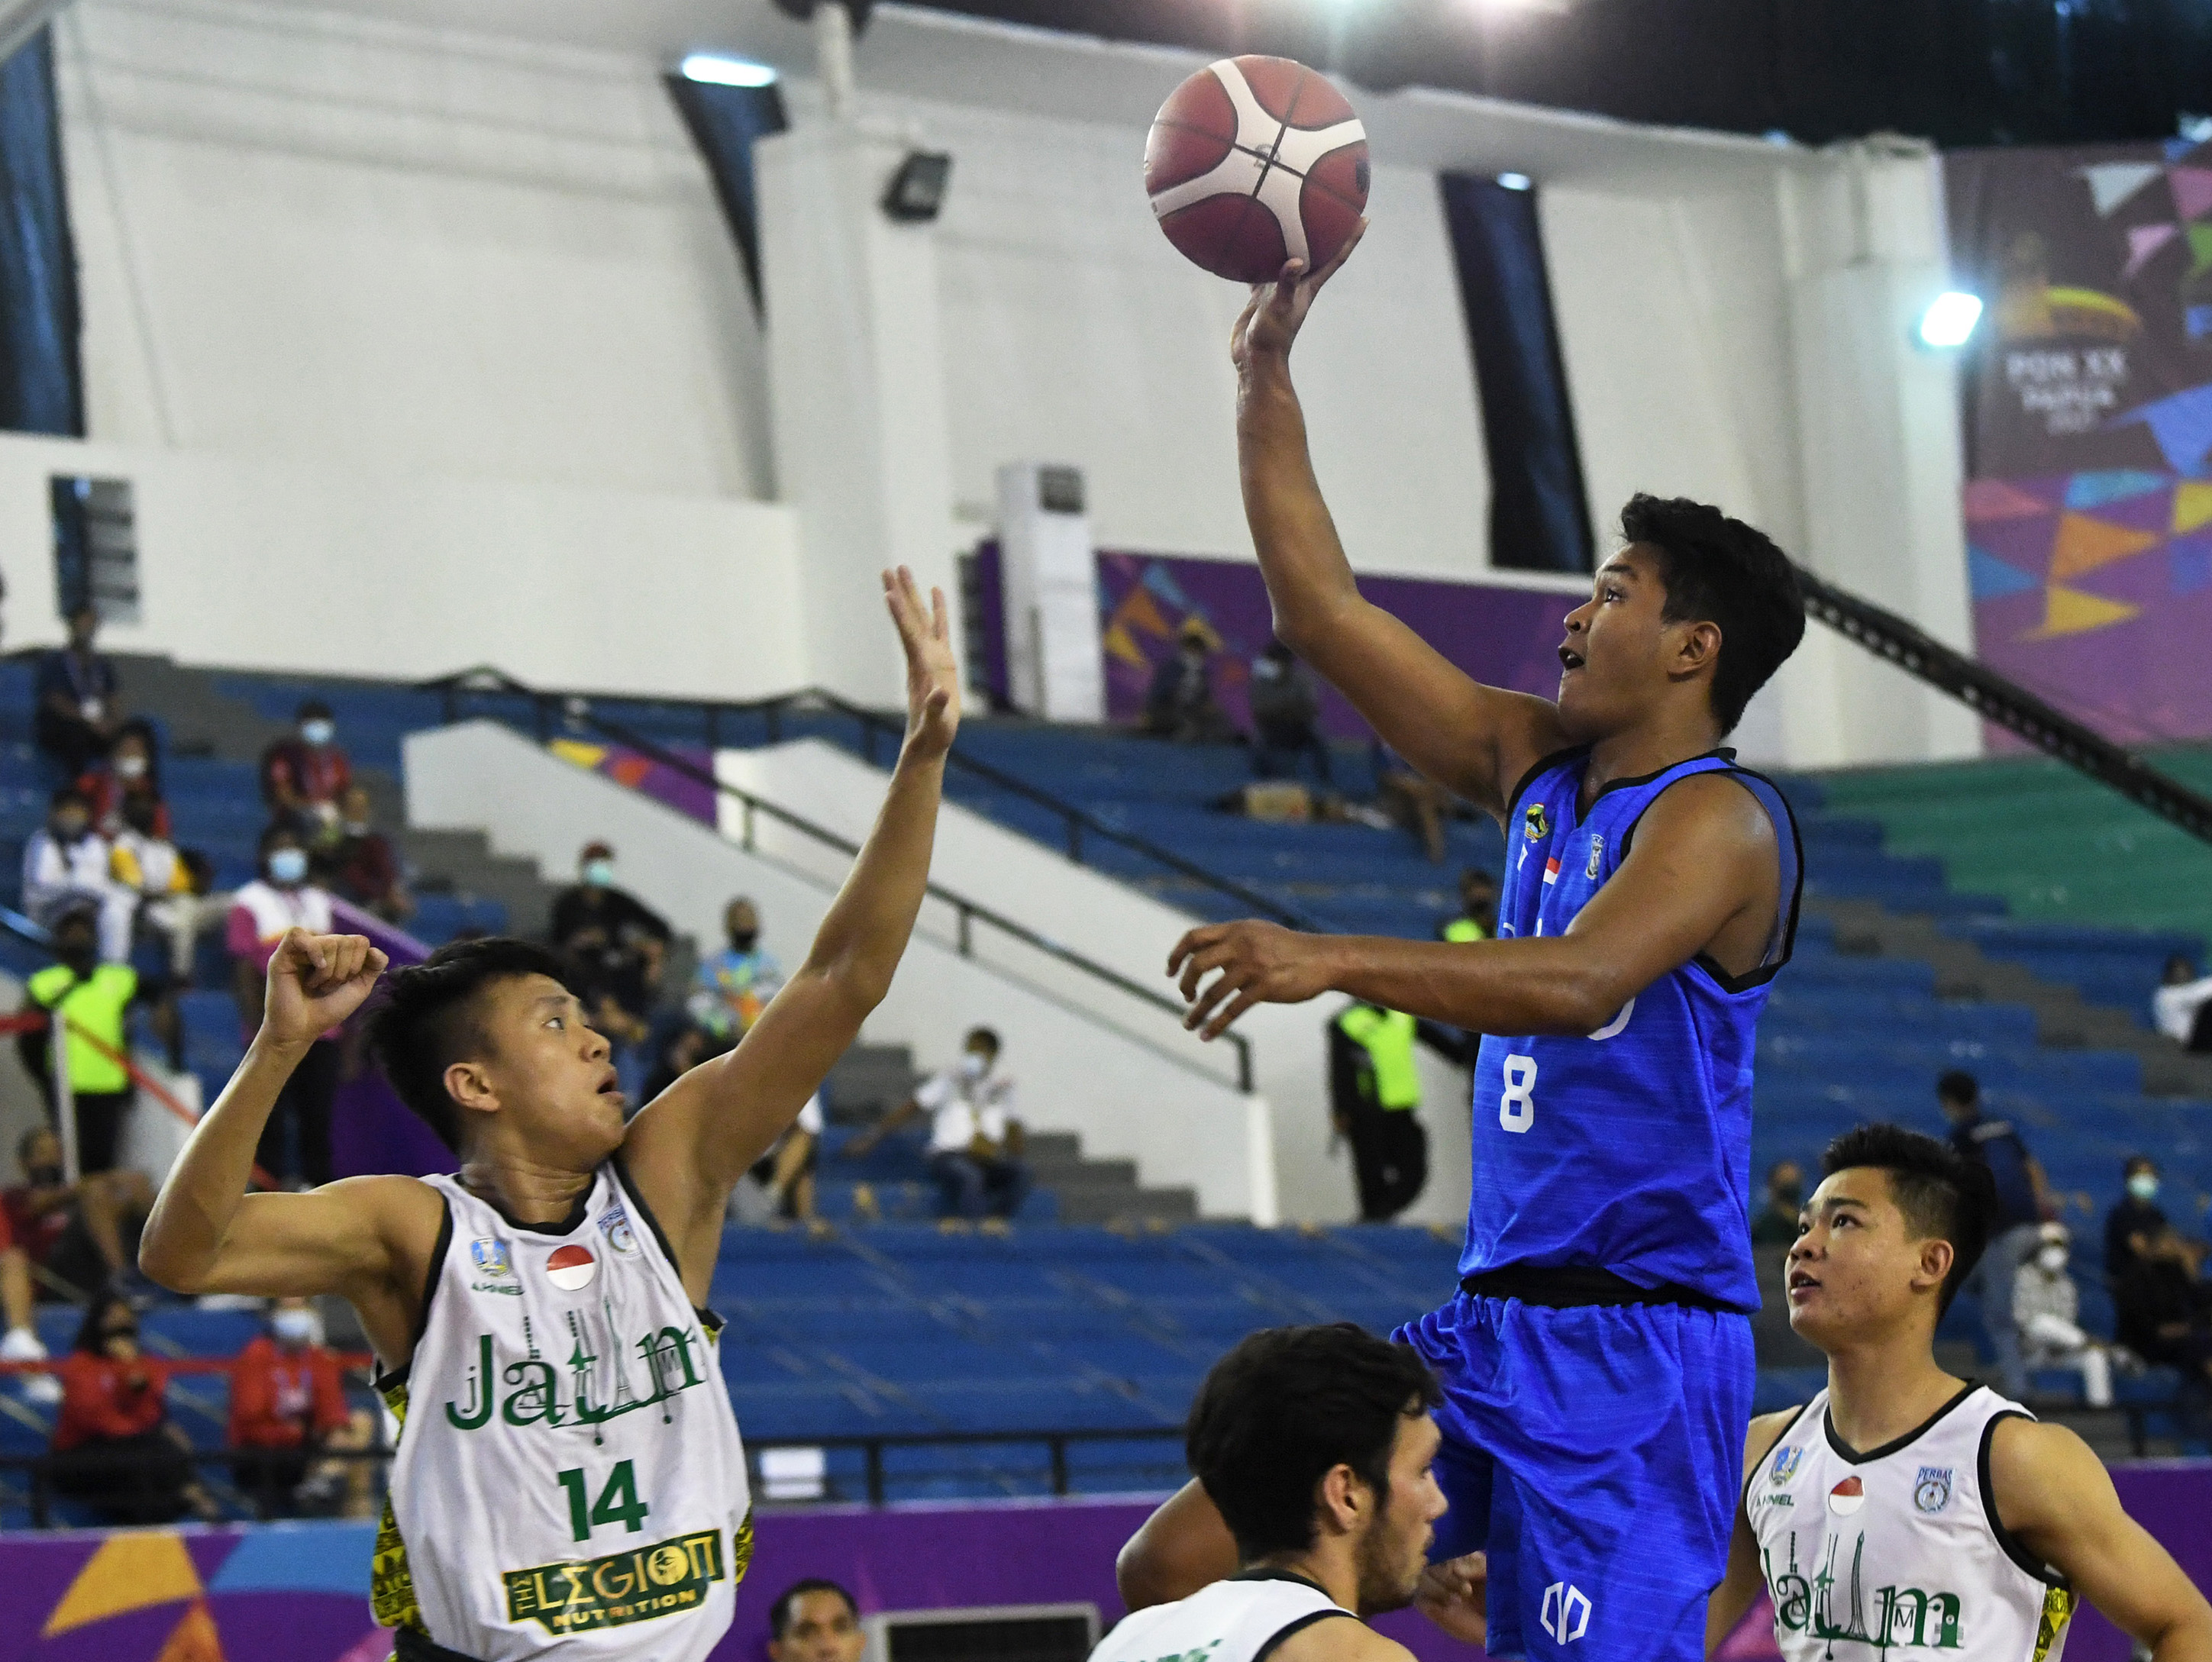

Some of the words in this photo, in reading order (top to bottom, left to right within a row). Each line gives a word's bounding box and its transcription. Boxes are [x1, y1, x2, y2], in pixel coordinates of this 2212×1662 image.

[1500, 1054, 1538, 1134] 8
[558, 1459, 649, 1542] 14
[552, 1588, 697, 1628] NUTRITION
